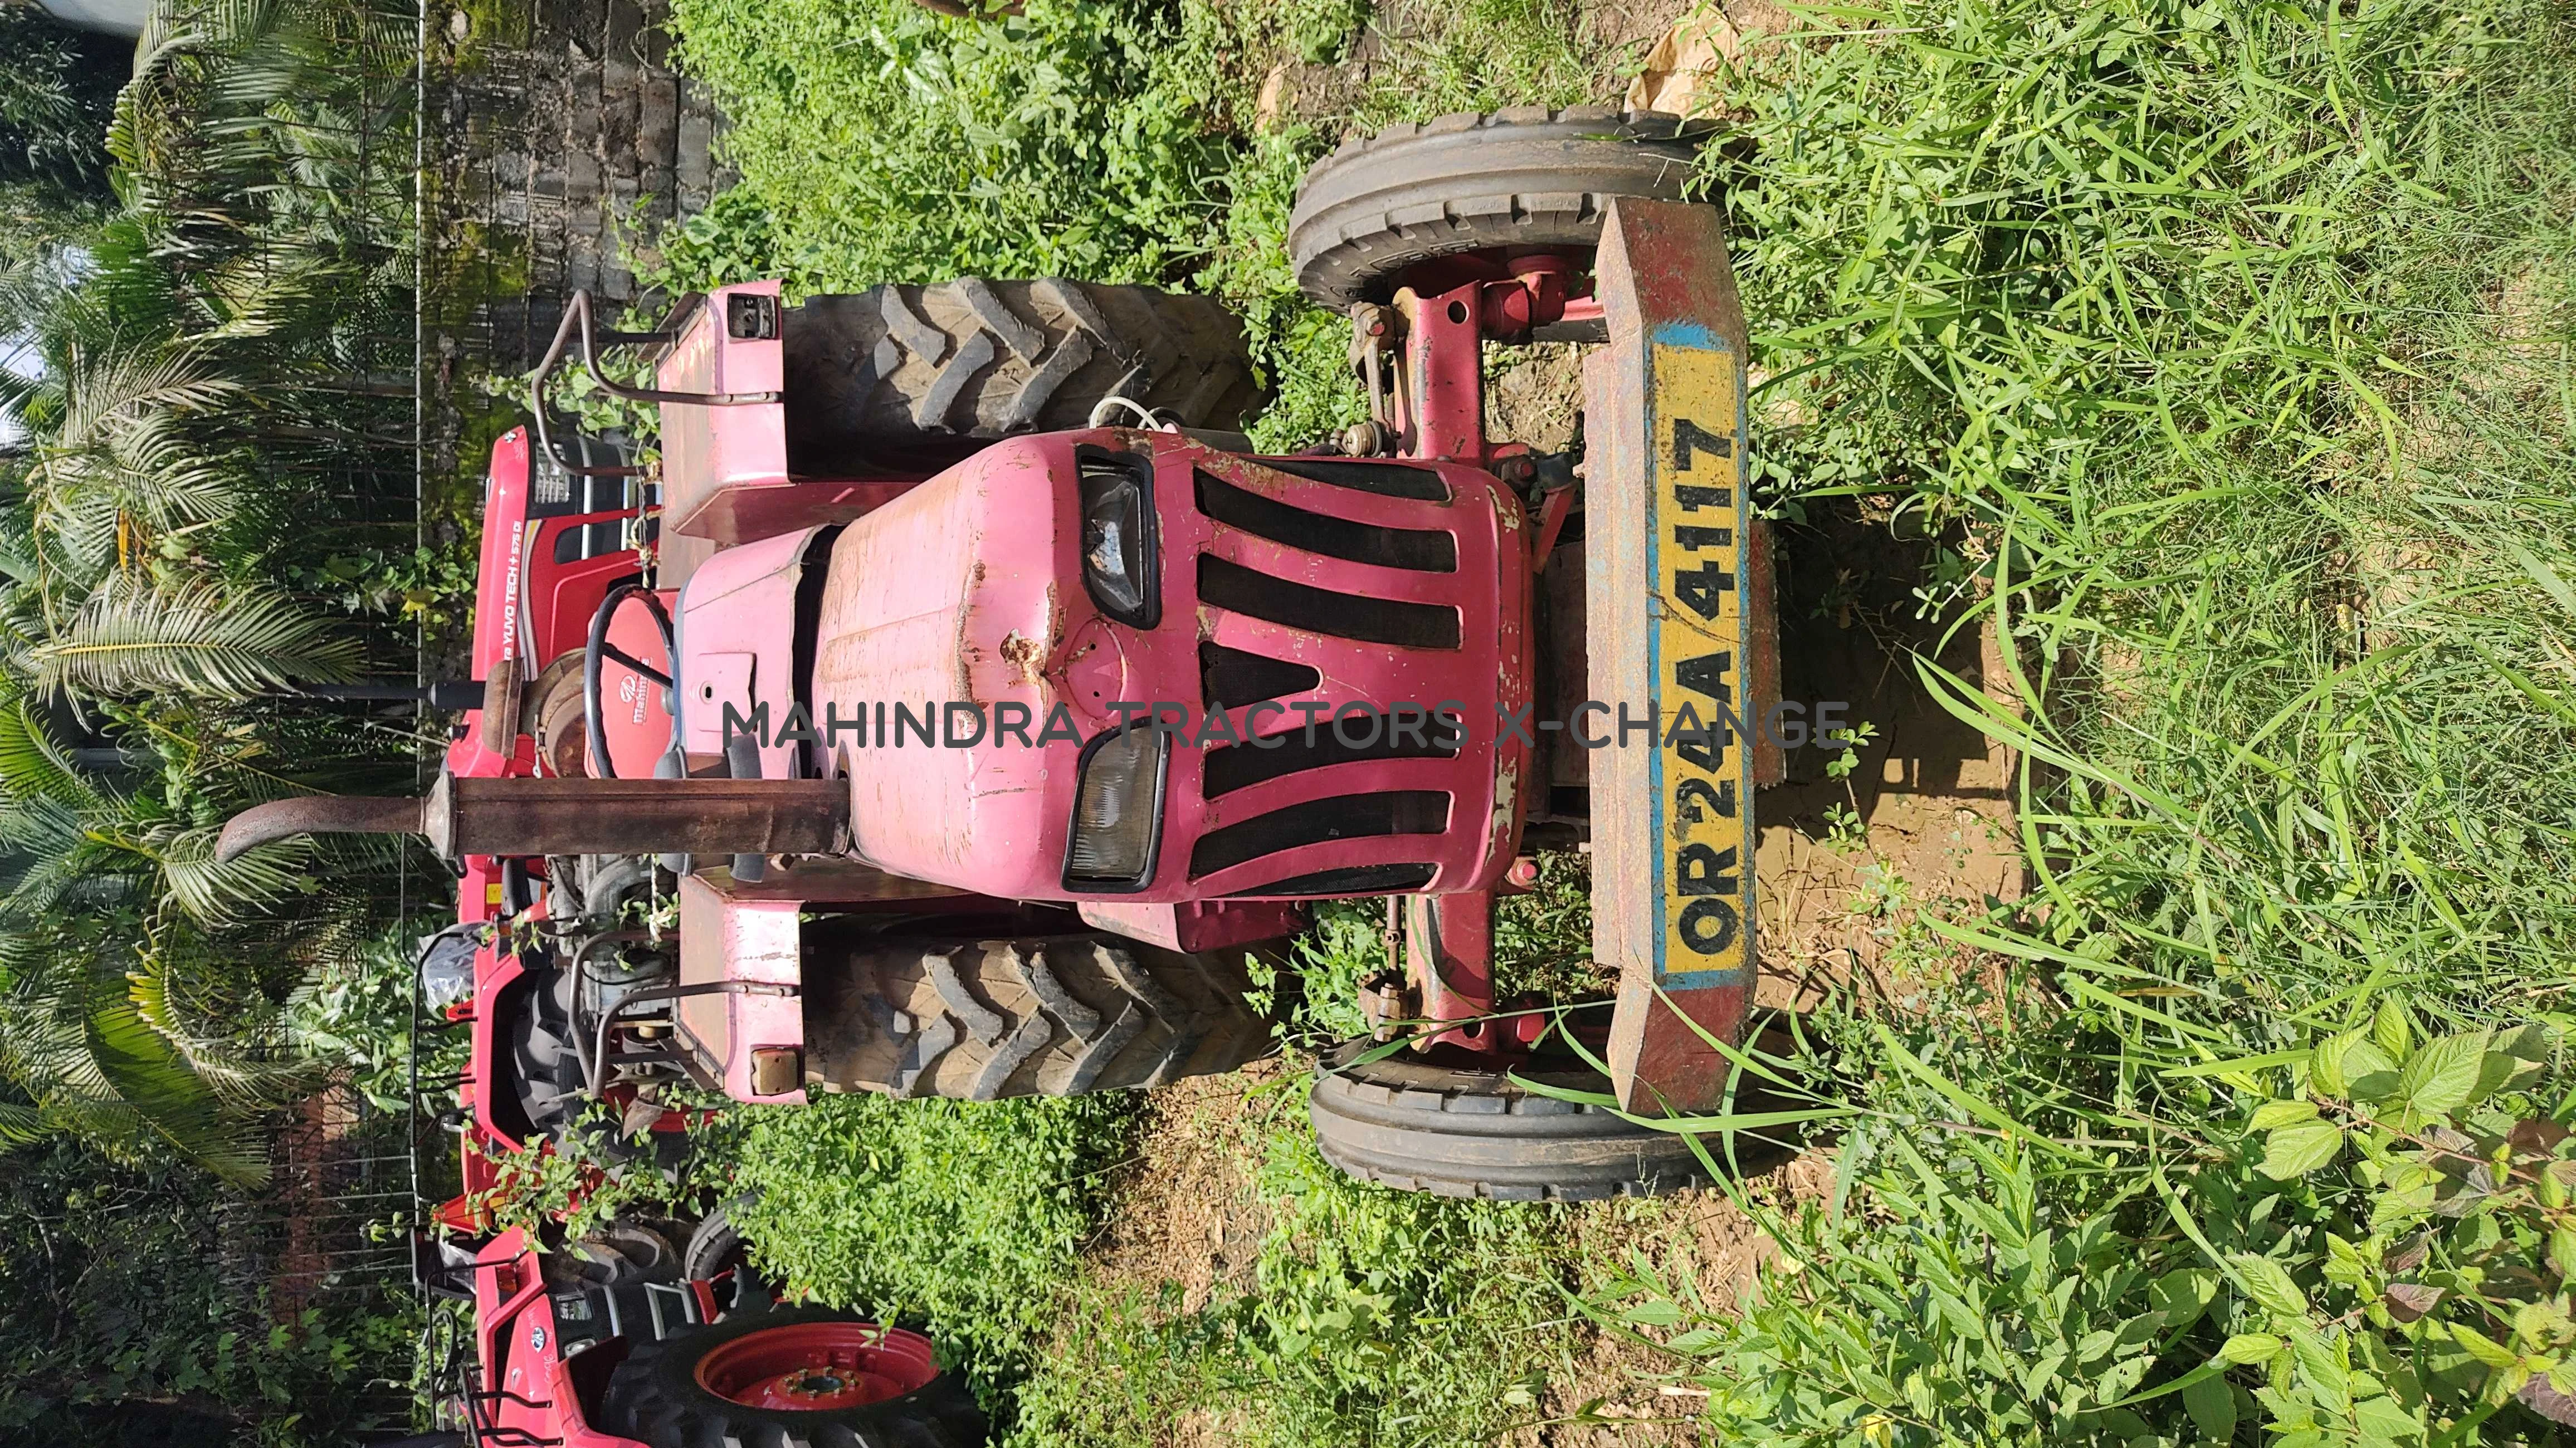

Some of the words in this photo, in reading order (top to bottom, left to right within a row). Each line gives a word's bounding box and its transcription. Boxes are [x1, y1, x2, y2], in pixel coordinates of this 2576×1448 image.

[511, 533, 521, 555] 575
[1673, 418, 1735, 622] 4117
[505, 566, 518, 603] TECH
[502, 605, 515, 644] YUVO
[632, 657, 651, 723] Mahina
[1676, 842, 1738, 955] OR
